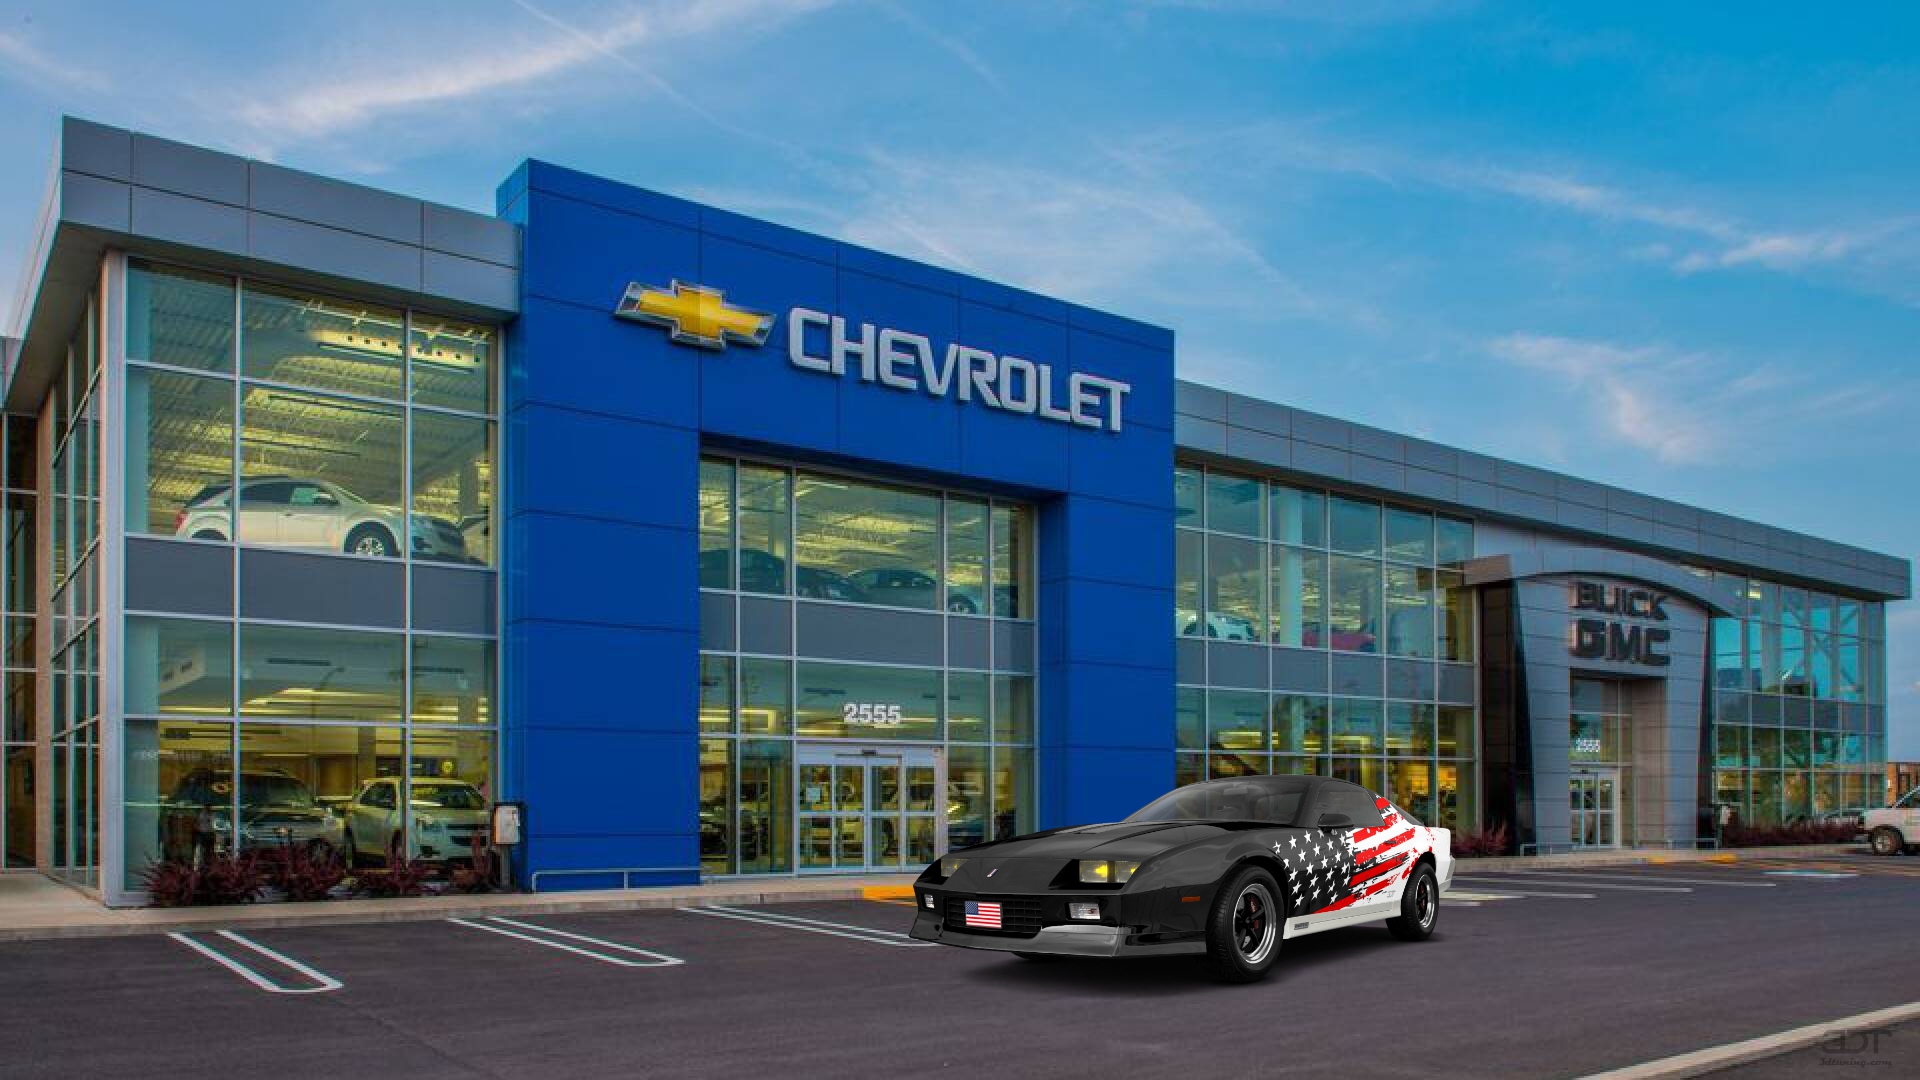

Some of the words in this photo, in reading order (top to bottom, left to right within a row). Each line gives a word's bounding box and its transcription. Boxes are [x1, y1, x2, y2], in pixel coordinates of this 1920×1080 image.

[788, 307, 1130, 432] CHEVROLET
[1571, 582, 1669, 620] BUICK
[1571, 618, 1671, 666] GMC
[843, 703, 901, 727] 2555
